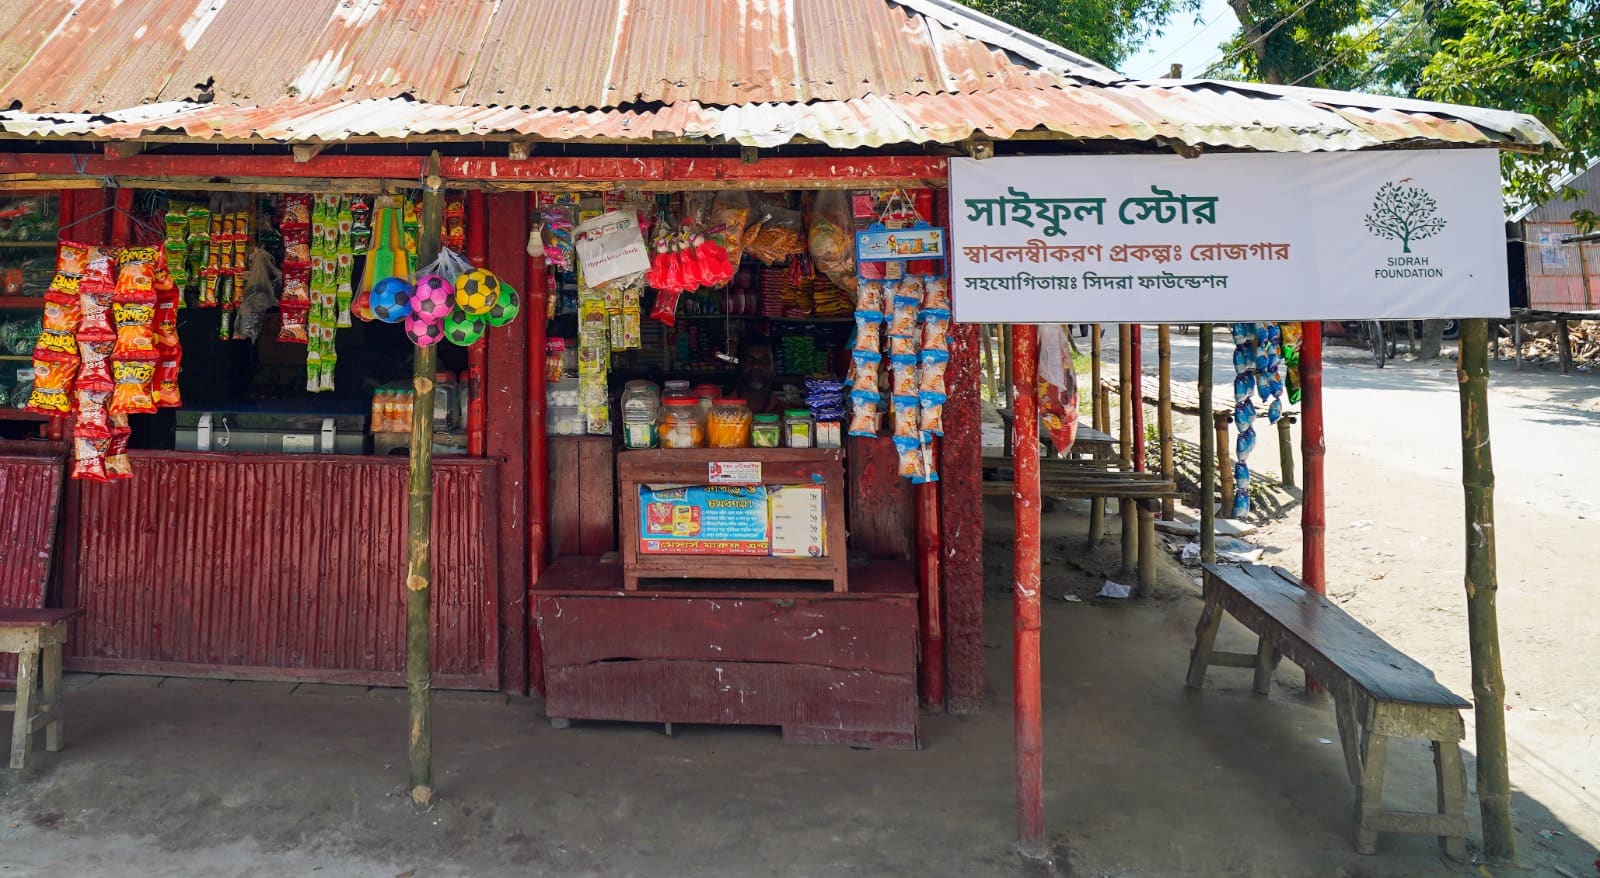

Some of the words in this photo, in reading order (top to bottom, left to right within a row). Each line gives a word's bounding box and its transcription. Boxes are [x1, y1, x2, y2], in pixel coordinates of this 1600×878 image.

[965, 186, 1107, 237] সাইফুল
[1119, 185, 1219, 225] স্টোর
[963, 238, 1103, 263] স্বাবলম্বীকরণ
[1109, 243, 1182, 264] প্রকল্পঃ
[1190, 242, 1290, 262] রোজগার
[1387, 257, 1429, 266] SIDRAH
[964, 271, 1078, 291] সহযোগিতায়ঃ
[1083, 271, 1134, 290] সিদরা
[1138, 271, 1228, 290] ফাউন্ডেশন
[1375, 268, 1443, 278] FOUNDATION
